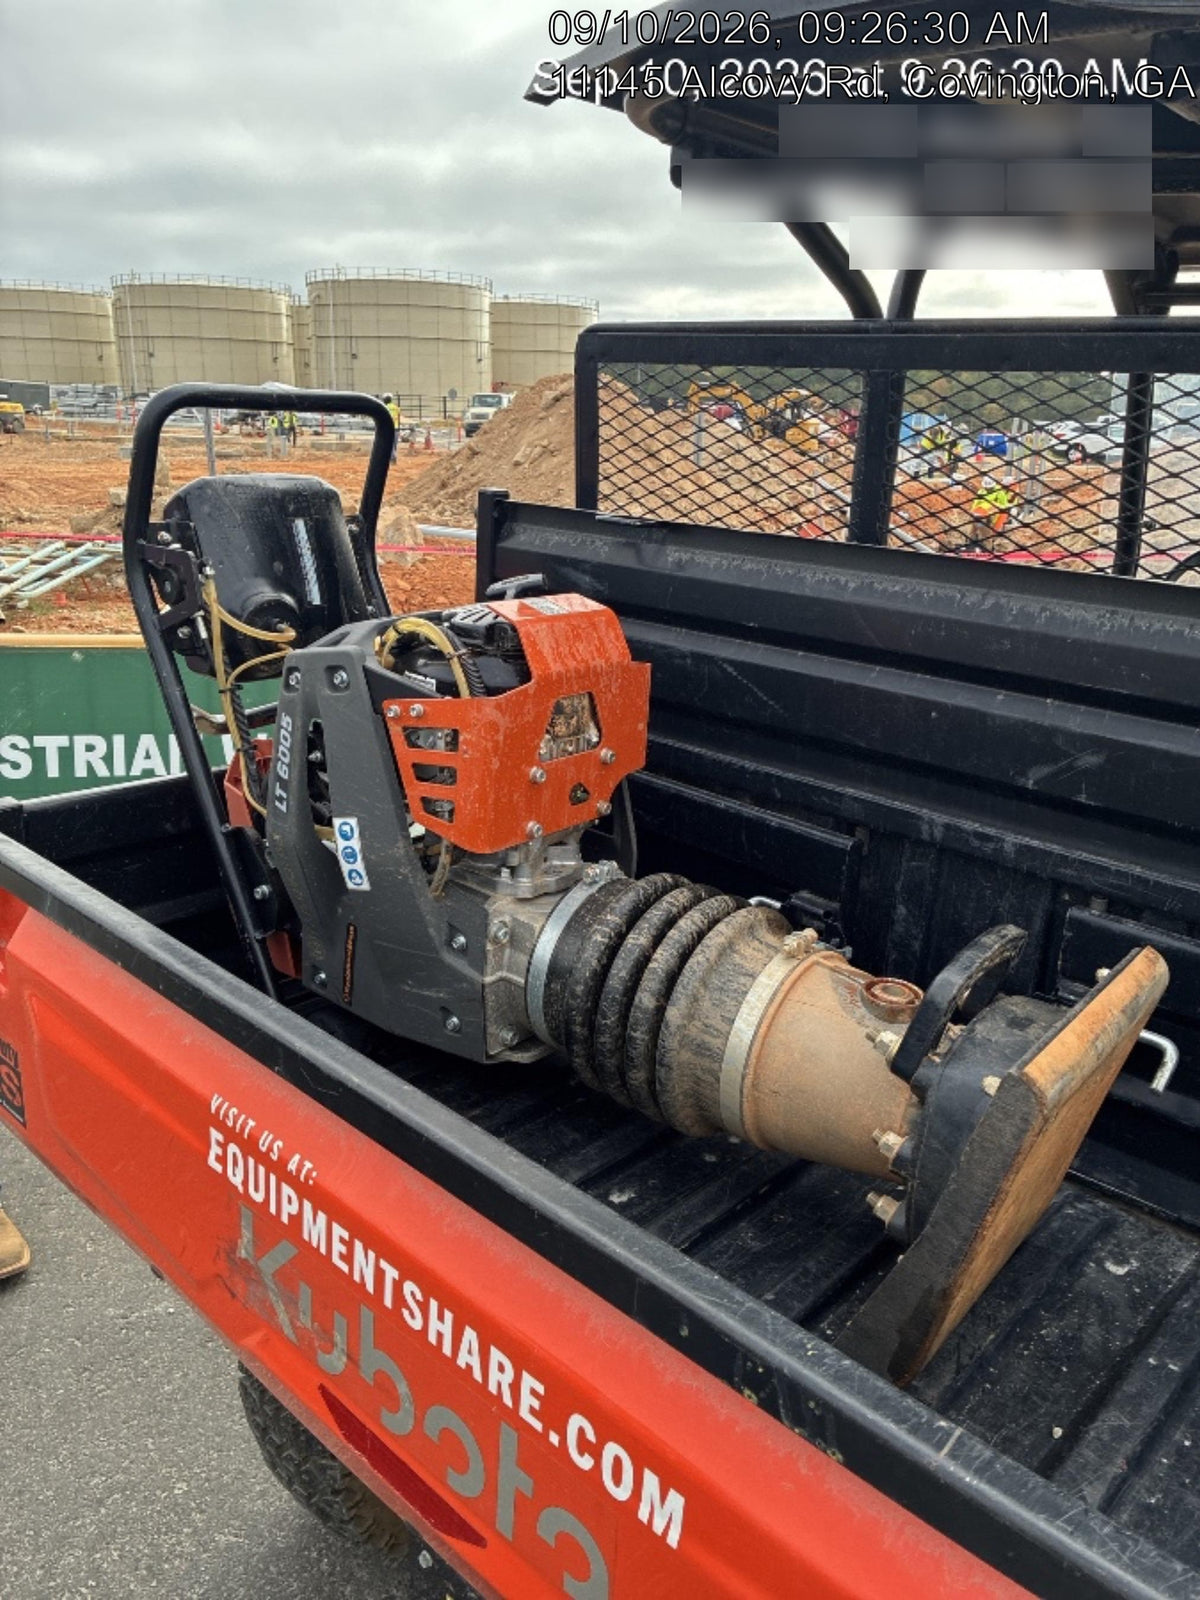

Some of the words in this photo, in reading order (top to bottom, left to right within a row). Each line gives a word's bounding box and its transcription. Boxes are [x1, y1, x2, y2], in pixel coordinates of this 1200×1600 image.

[277, 711, 292, 780] 6005
[275, 781, 288, 813] LT
[210, 1092, 257, 1140] VISIT
[258, 1130, 284, 1162] US
[287, 1152, 318, 1185] AT:
[207, 1126, 686, 1550] EQUIPMENTSHARE.COM
